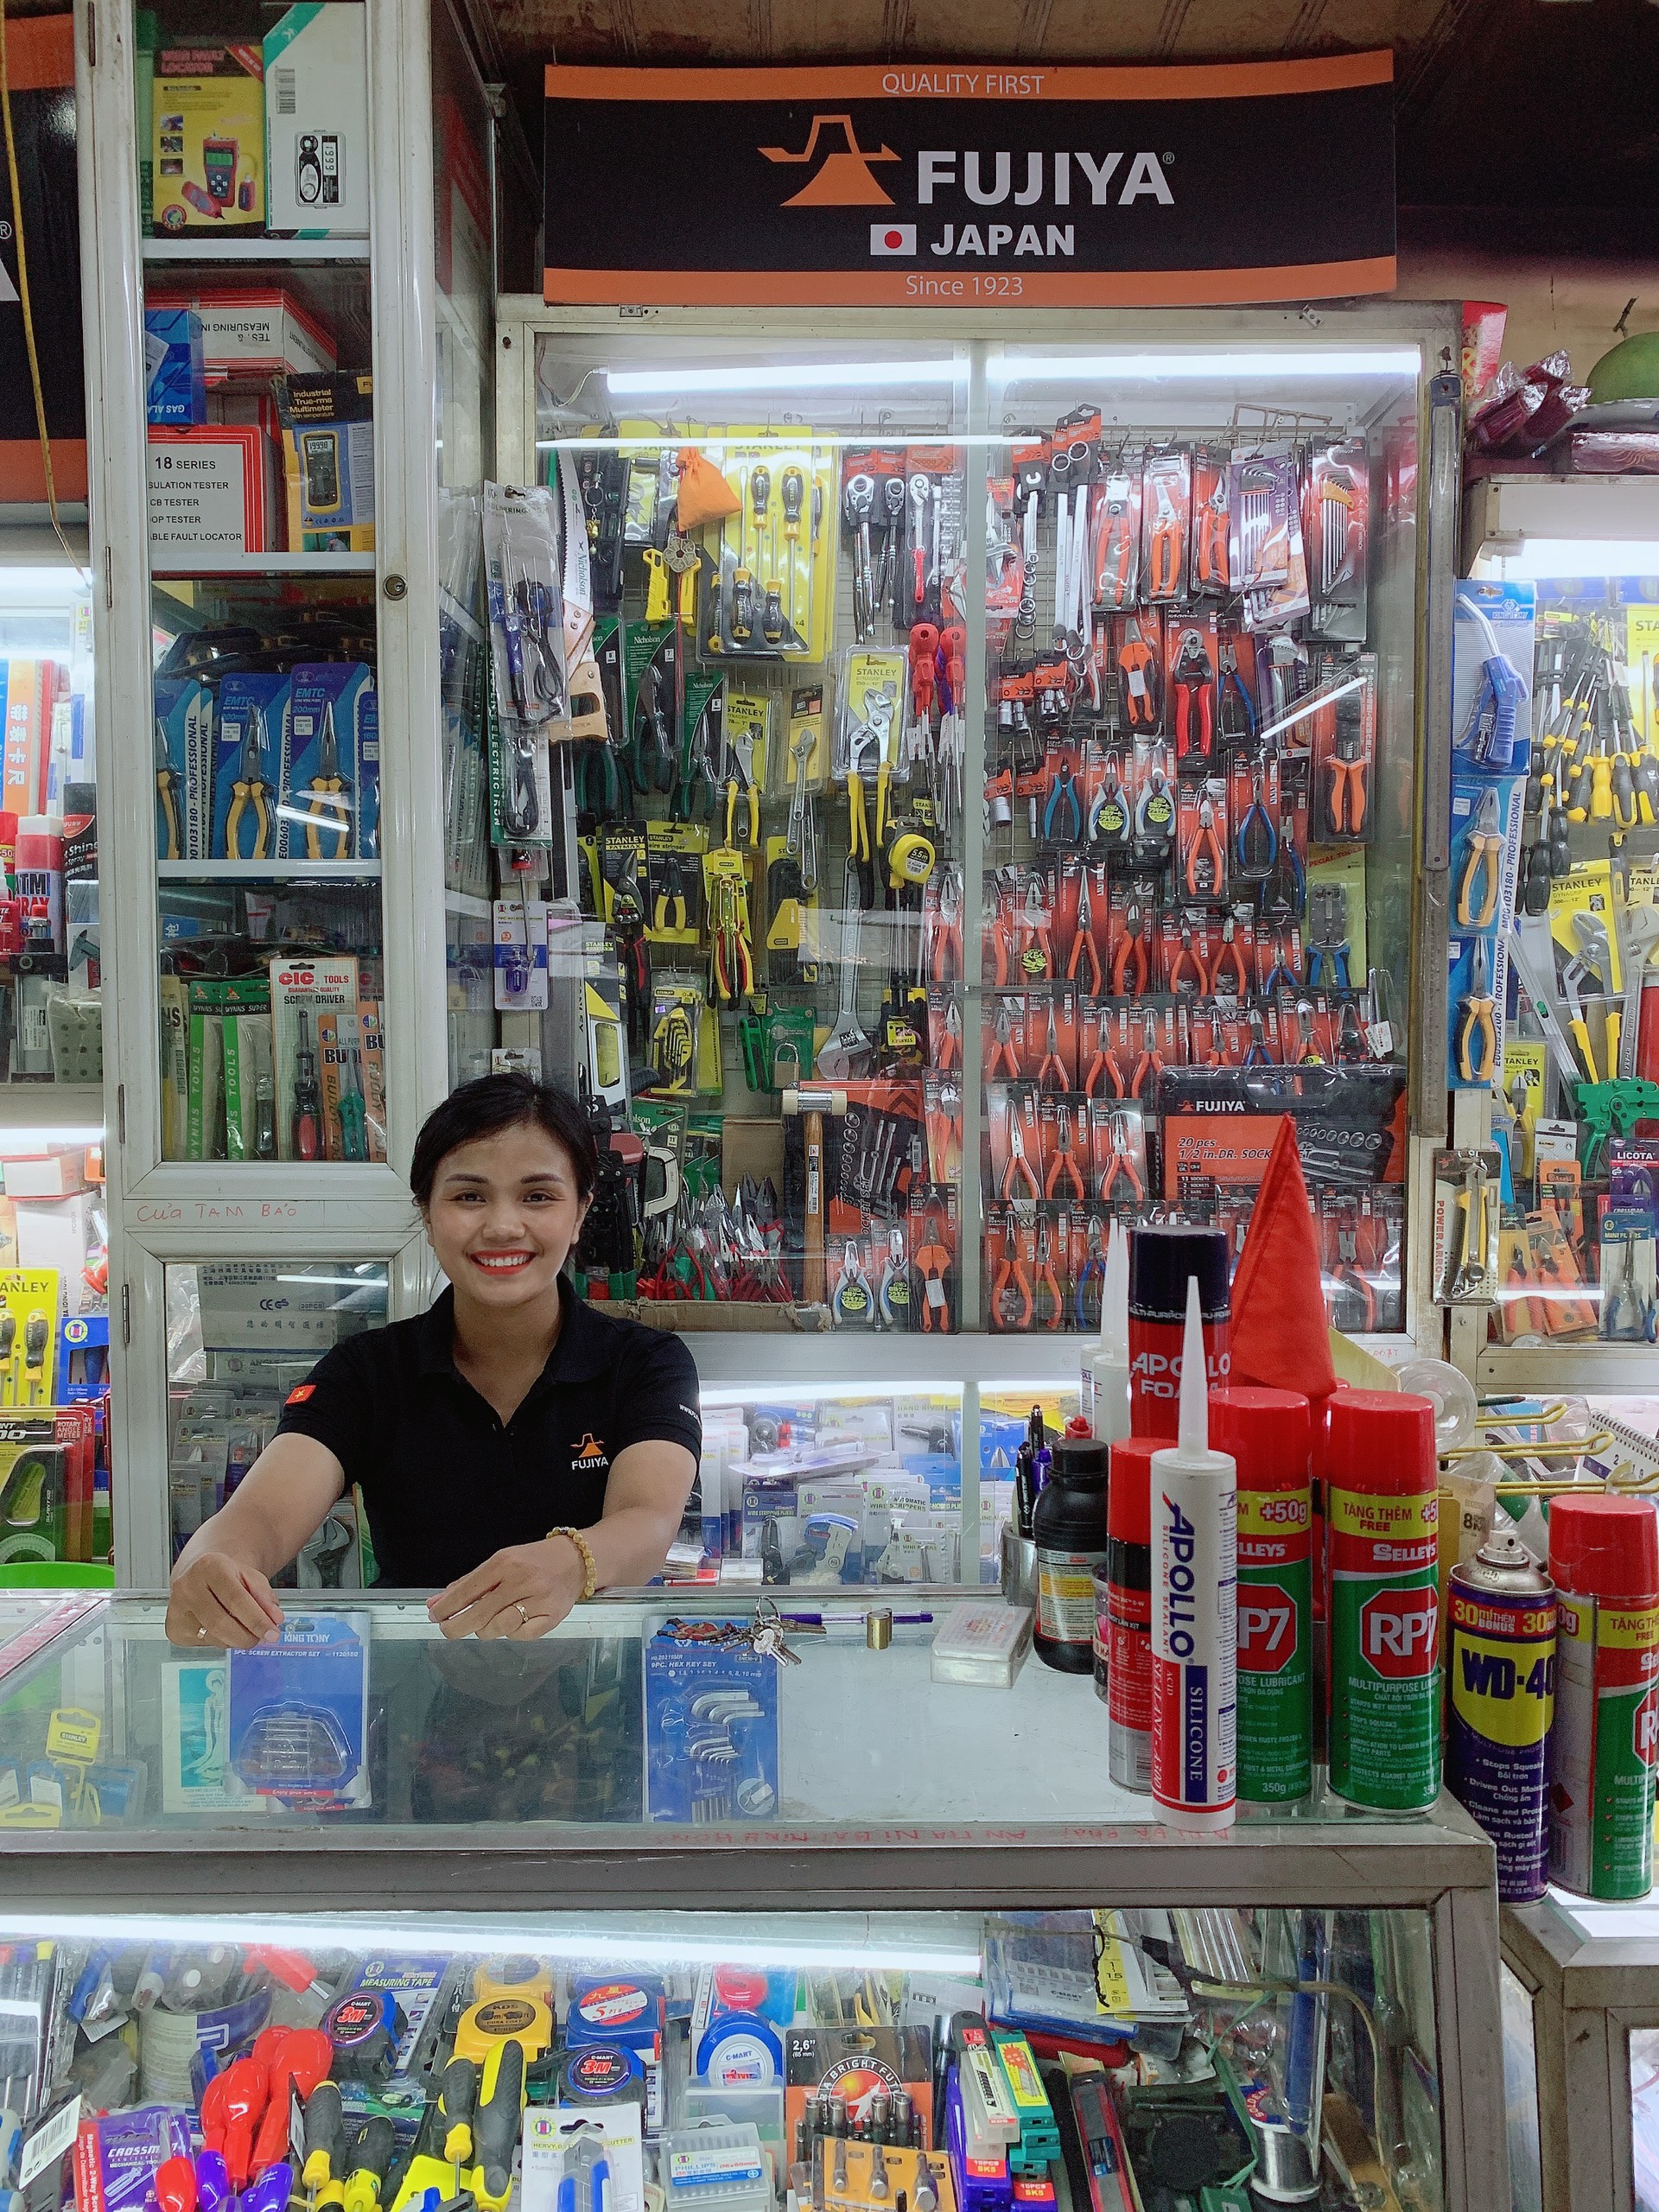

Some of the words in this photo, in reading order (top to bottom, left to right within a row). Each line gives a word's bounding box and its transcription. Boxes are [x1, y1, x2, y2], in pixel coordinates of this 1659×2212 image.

[882, 72, 980, 97] QUALITY
[986, 73, 1044, 96] FIRST
[918, 150, 1175, 207] FUJIYA
[931, 224, 1075, 257] JAPAN
[906, 275, 964, 296] Since
[970, 275, 1023, 296] 1923
[213, 321, 270, 332] MEASURING
[292, 389, 332, 397] Industrial
[167, 404, 186, 413] GAS
[289, 404, 334, 413] Multimeter
[155, 457, 173, 470] 18
[176, 460, 216, 470] SERIES
[194, 480, 229, 490] TESTER
[164, 499, 200, 507] TESTER
[165, 516, 201, 524] TESTER
[171, 533, 198, 542] FAULT
[200, 533, 242, 542] LOCATOR
[576, 552, 588, 596] Nicholson
[633, 635, 661, 644] Nicholson
[856, 668, 897, 677] STANLEY
[295, 688, 326, 698] EMTC
[727, 704, 765, 717] STANLEY
[188, 715, 199, 800] PROFESSIONAL
[491, 724, 501, 790] ELECTRIC
[1507, 791, 1522, 866] PROFESSIONAL
[605, 835, 645, 844] STANLEY
[1552, 878, 1602, 892] STANLEY
[278, 971, 315, 985] CIC
[324, 975, 349, 985] TOOLS
[315, 995, 346, 1005] DRIVER
[191, 1046, 201, 1094] TOOLS
[226, 1047, 236, 1096] TOOLS
[1196, 1101, 1244, 1112] FUJIYA
[189, 1107, 200, 1160] WYNNS
[1178, 1137, 1193, 1147] 20
[1196, 1140, 1216, 1149] pcs
[1179, 1149, 1200, 1160] 1/2
[1617, 1151, 1654, 1160] LICOTA
[195, 1205, 244, 1217] TAM
[1130, 1352, 1231, 1377] APOLO
[57, 1420, 81, 1428] ROTARY
[571, 1457, 609, 1471] FUJIYA
[1613, 1454, 1619, 1465] 2
[1260, 1499, 1307, 1523] +50g
[1377, 1504, 1412, 1521] THÊM
[1359, 1520, 1390, 1533] FREE
[1372, 1542, 1436, 1563] SELLEYS
[1161, 1491, 1196, 1659] APOLLO
[1370, 1607, 1438, 1657] RP7
[1478, 1619, 1516, 1634] BONUS
[284, 1634, 304, 1643] KING
[1636, 1630, 1654, 1642] FREE
[1461, 1647, 1554, 1700] WD-40
[1348, 1675, 1419, 1693] MULTIPURPOSE
[1152, 1658, 1164, 1739] SEALANT
[60, 1732, 88, 1742] STANLEY
[1190, 1687, 1204, 1782] SILICONE
[1483, 1758, 1510, 1770] Stops
[1262, 1782, 1287, 1796] 350g
[1469, 1777, 1498, 1792] Drives
[1501, 1784, 1519, 1793] Out
[1469, 1800, 1499, 1814] Cleans
[1502, 1807, 1519, 1815] and
[1503, 1831, 1534, 1840] Rusted
[359, 1978, 410, 1987] MEASURING
[411, 1977, 434, 1987] TAPE
[336, 2006, 366, 2024] 3M
[725, 2050, 753, 2062] C-MART
[581, 2060, 612, 2075] 3M
[829, 2057, 878, 2081] BRIGHT
[86, 2133, 97, 2169] Magnetic
[675, 2162, 716, 2171] PHILLIPS
[977, 2165, 996, 2174] SK5
[89, 2170, 98, 2194] 2-Way
